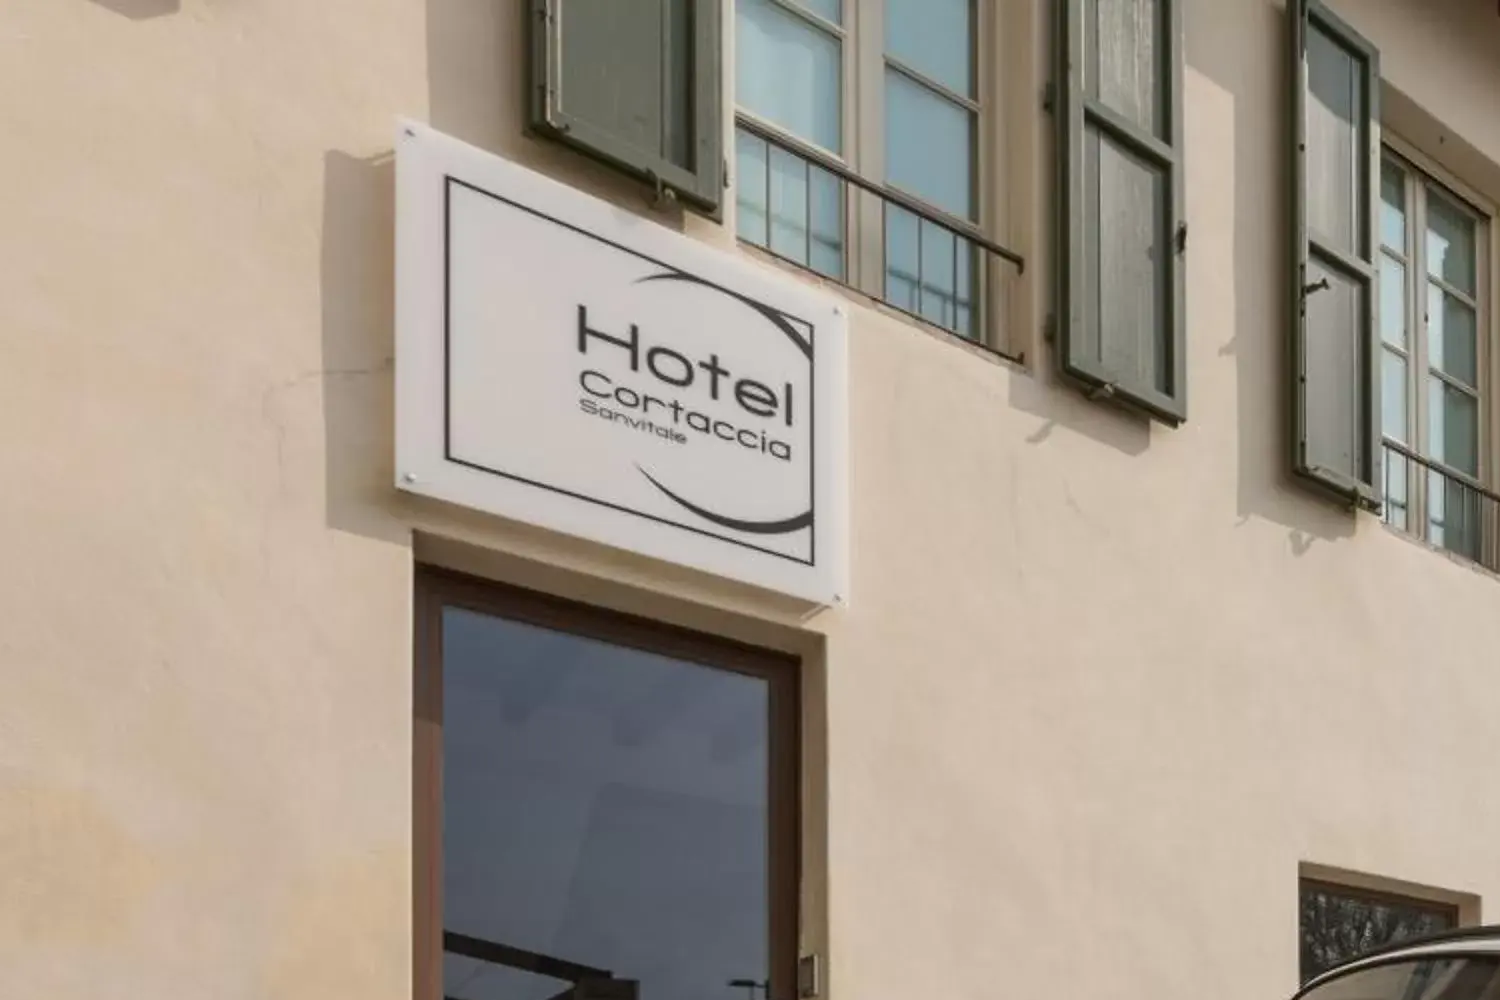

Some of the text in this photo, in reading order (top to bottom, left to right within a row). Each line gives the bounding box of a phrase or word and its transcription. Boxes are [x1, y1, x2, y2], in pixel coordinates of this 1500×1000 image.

[577, 304, 793, 427] Hotel
[578, 398, 687, 444] Sanvitale
[579, 370, 791, 461] Cortaccia
